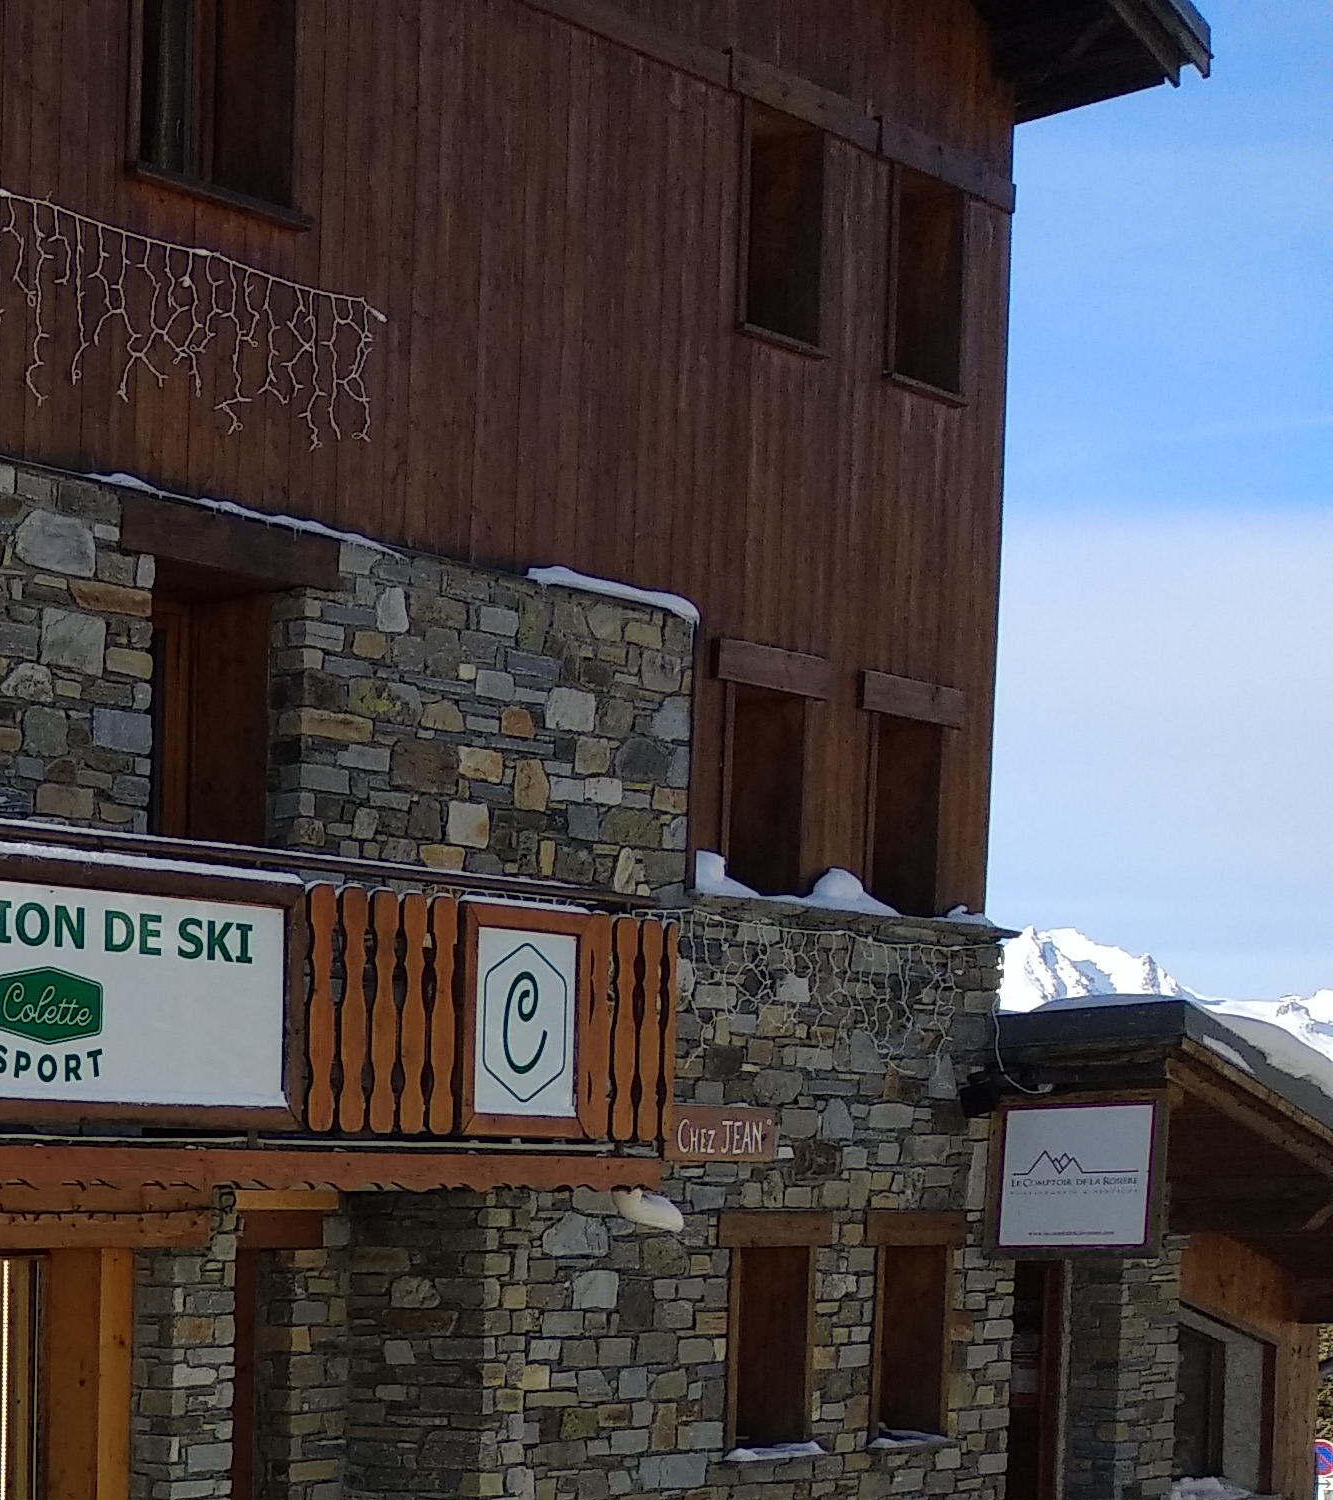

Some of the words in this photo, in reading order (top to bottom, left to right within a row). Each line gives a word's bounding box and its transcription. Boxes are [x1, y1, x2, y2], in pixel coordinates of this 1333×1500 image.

[103, 909, 163, 957] DE
[176, 917, 254, 965] SKI
[2, 981, 94, 1027] Colette
[720, 1120, 763, 1155] JEAN
